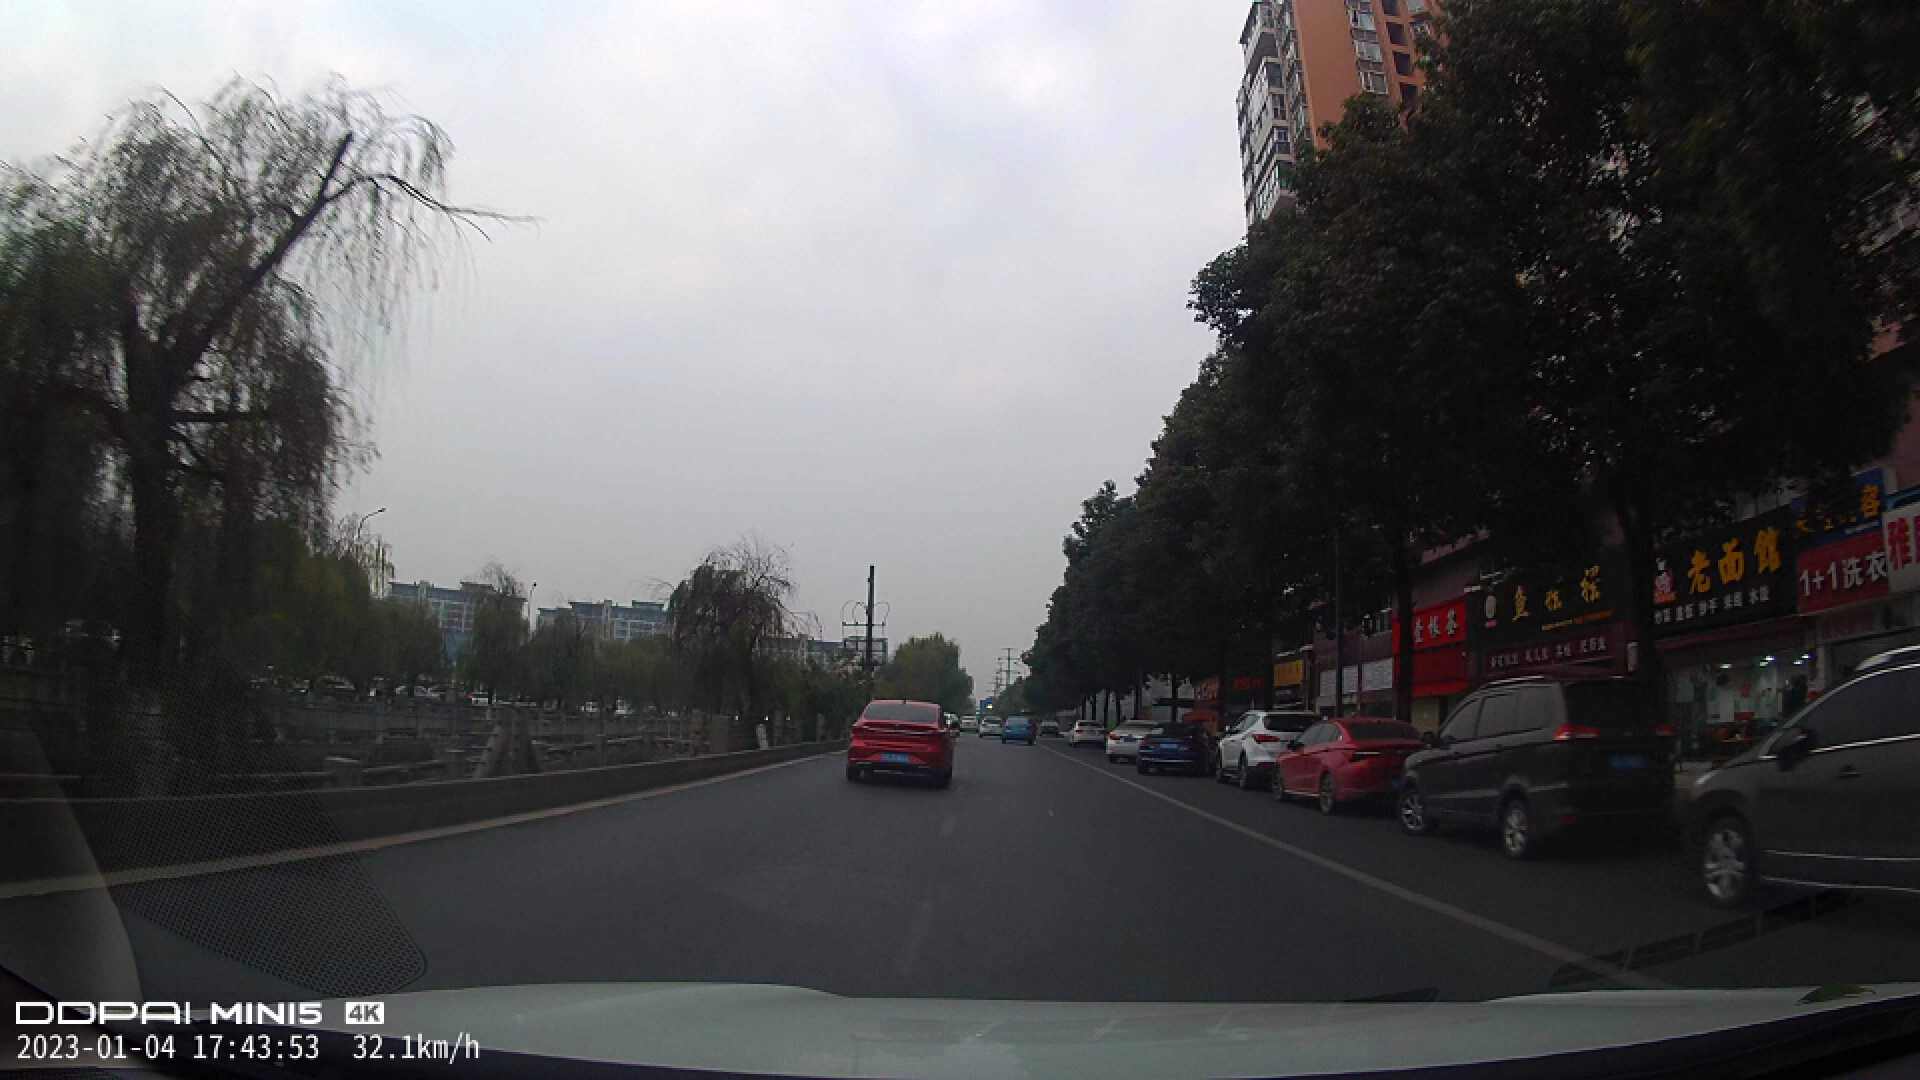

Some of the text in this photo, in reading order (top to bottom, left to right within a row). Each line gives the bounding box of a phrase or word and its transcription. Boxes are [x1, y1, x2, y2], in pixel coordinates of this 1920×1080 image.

[1687, 526, 1783, 593] 老面馆
[1799, 551, 1888, 597] 1+1洗衣
